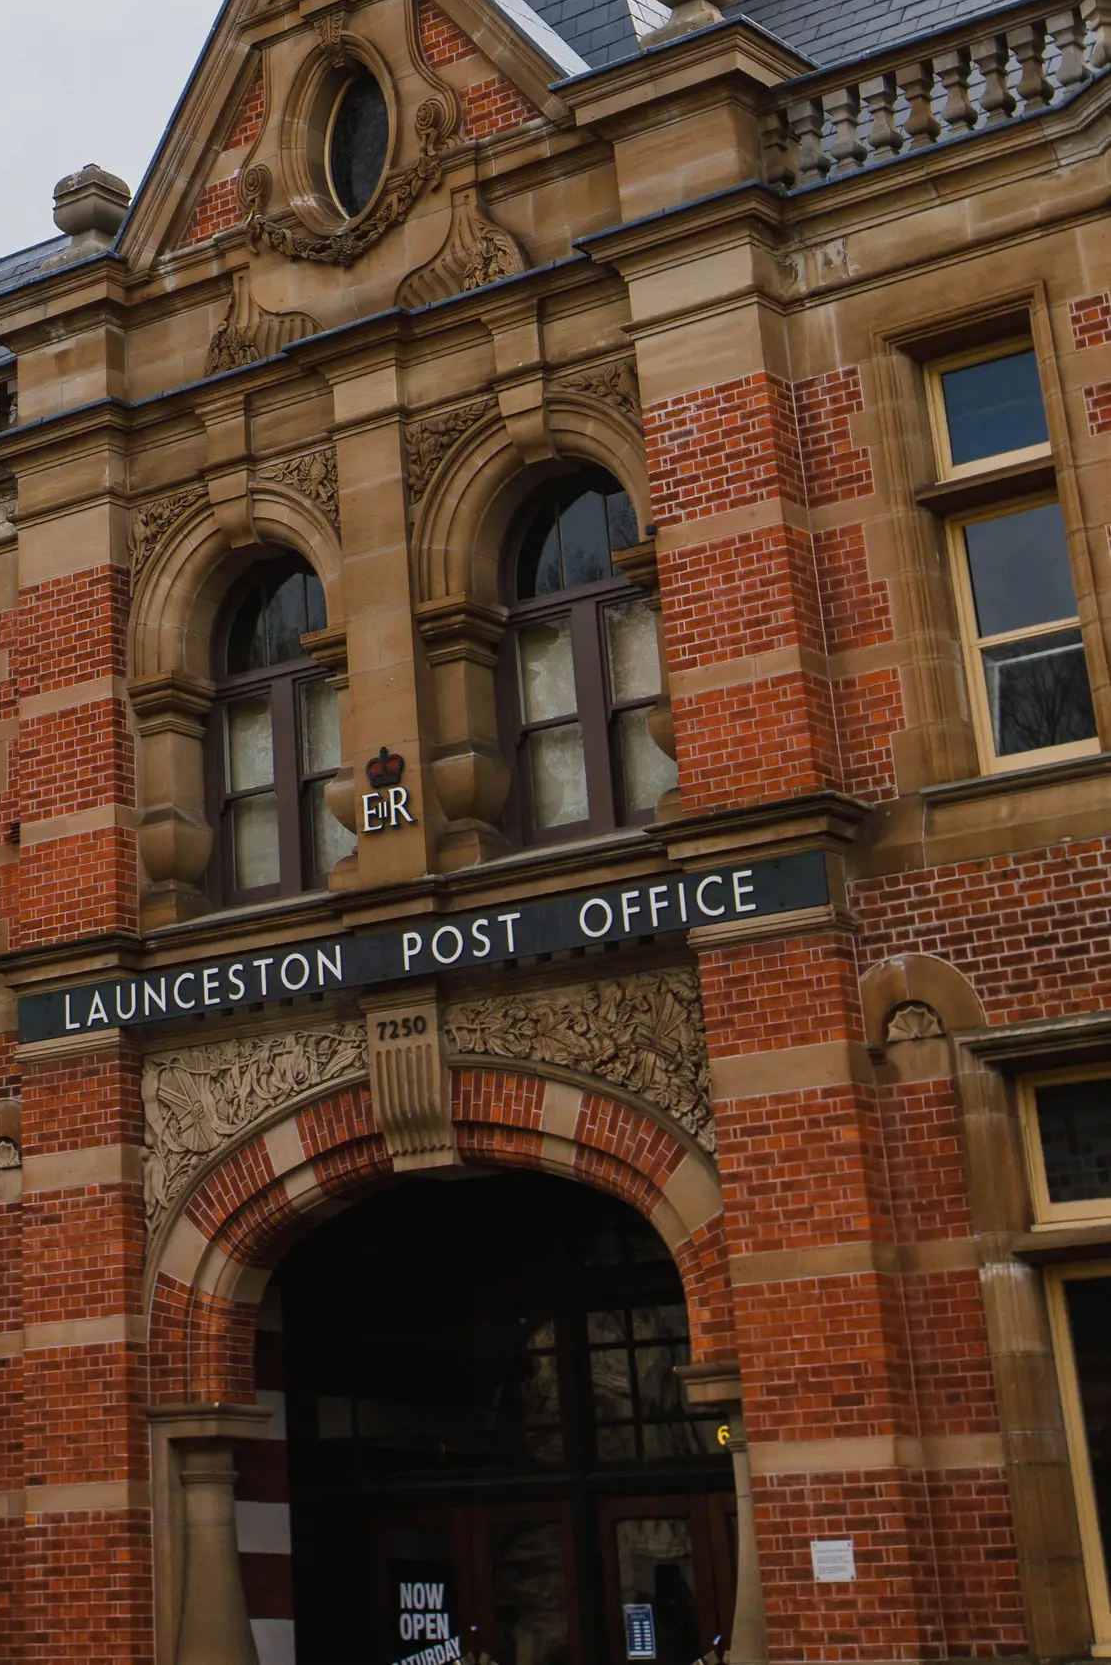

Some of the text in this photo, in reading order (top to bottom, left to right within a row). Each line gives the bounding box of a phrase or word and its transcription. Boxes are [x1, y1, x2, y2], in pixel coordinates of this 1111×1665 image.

[65, 869, 757, 1030] LAUNCESTON POST OFFICE
[376, 1015, 427, 1041] 7250
[399, 1582, 444, 1610] NOW
[399, 1613, 450, 1641] OPEN
